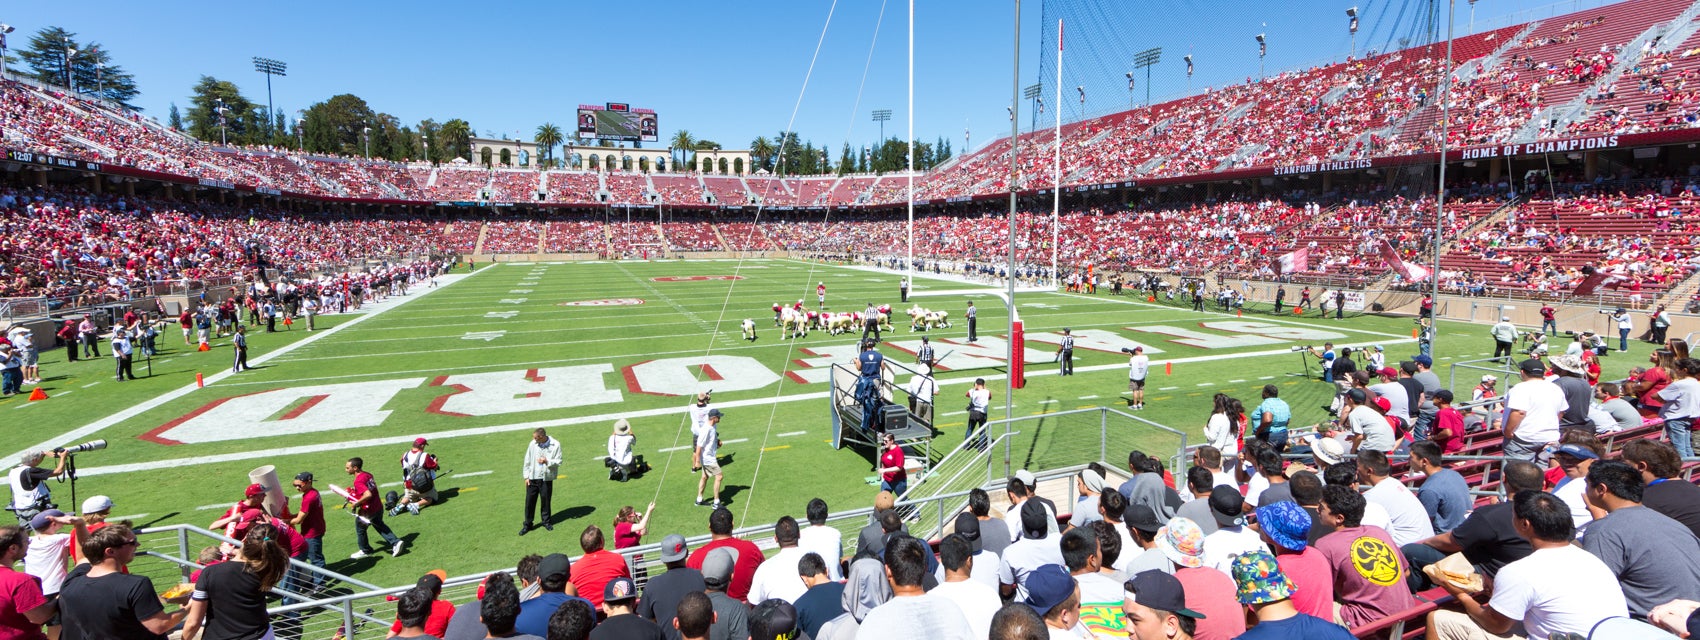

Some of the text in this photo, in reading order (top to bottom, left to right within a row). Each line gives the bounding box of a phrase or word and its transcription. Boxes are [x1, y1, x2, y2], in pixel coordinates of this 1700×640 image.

[13, 151, 33, 162] 12:07
[1462, 136, 1619, 160] HOME OF CHAMPIONS
[1274, 159, 1372, 176] STANFORD ATHLETICS
